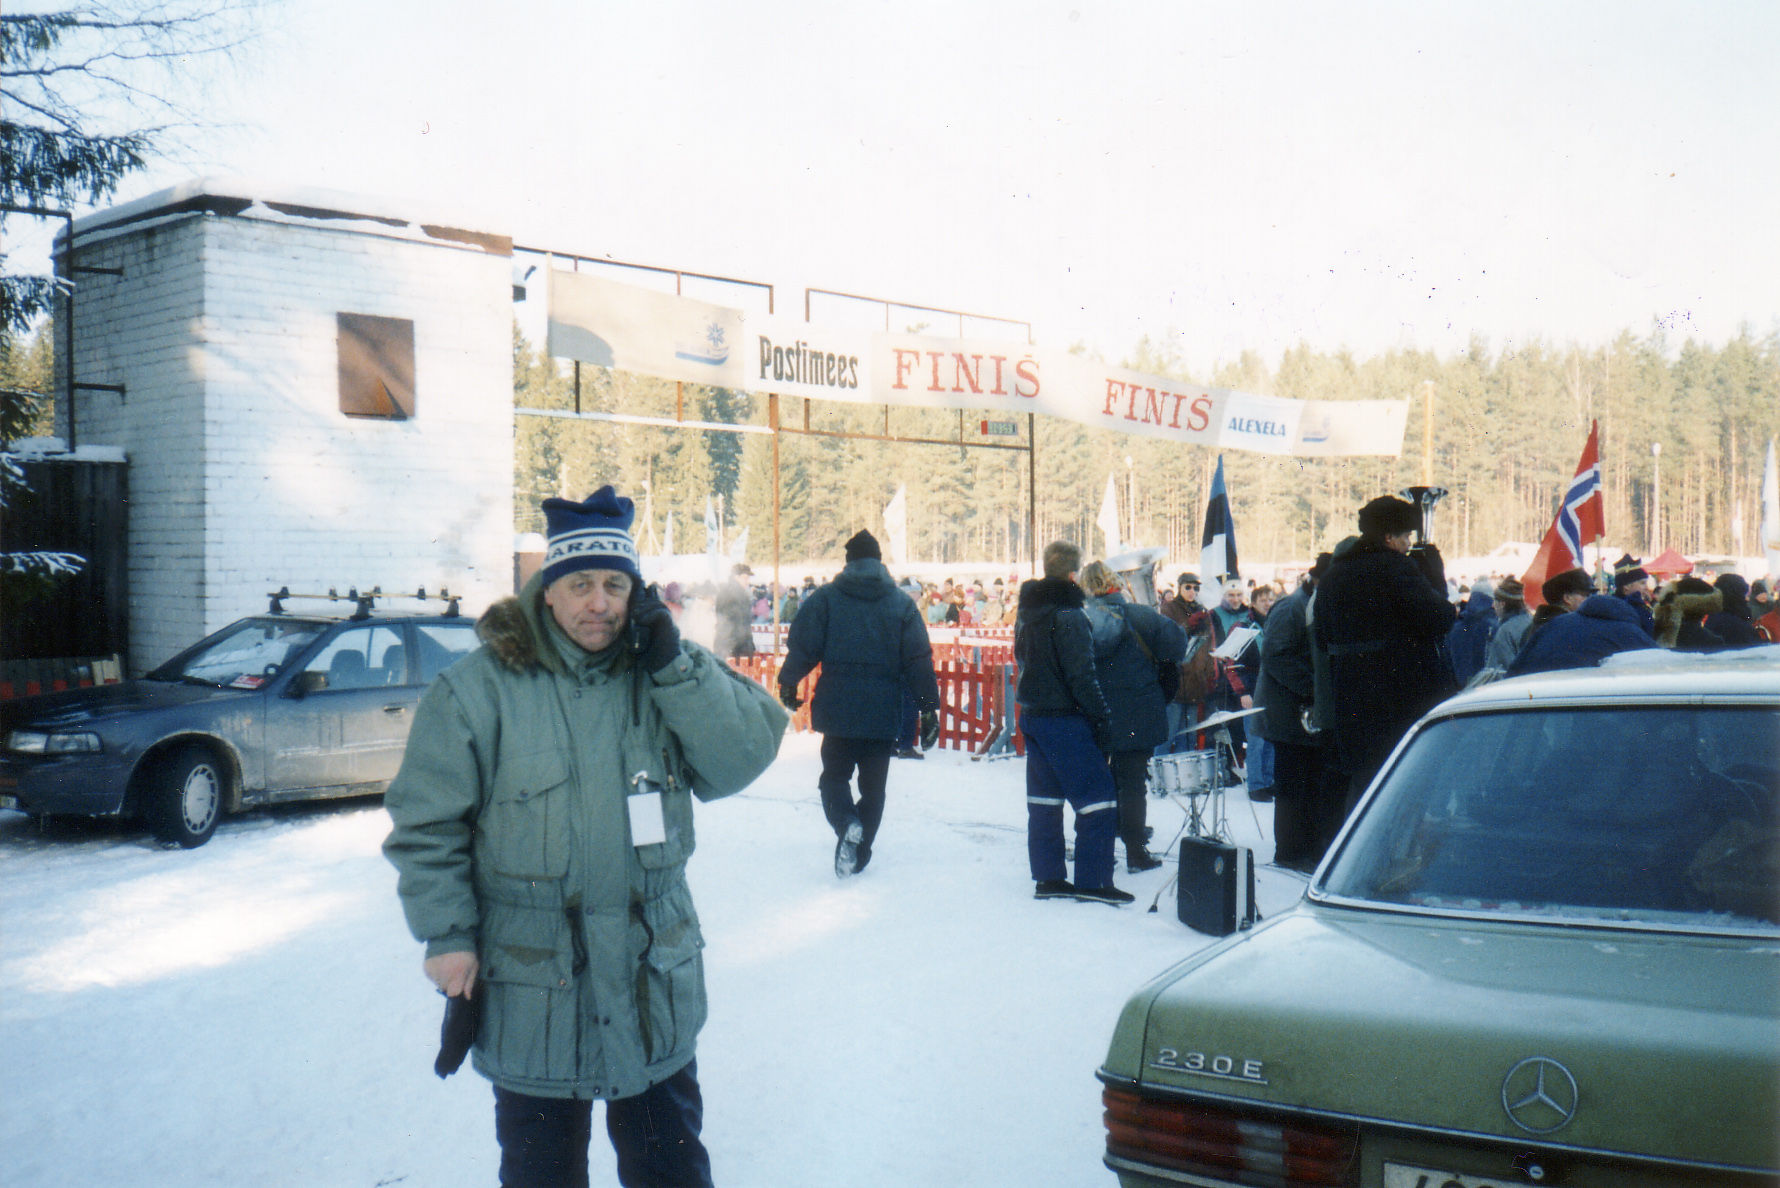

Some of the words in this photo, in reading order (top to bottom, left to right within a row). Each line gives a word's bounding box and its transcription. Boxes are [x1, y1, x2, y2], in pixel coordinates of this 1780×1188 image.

[758, 335, 858, 389] Postimees
[1228, 417, 1286, 436] ALEXELA
[546, 541, 631, 561] ARATO
[1157, 1048, 1264, 1079] 230E
